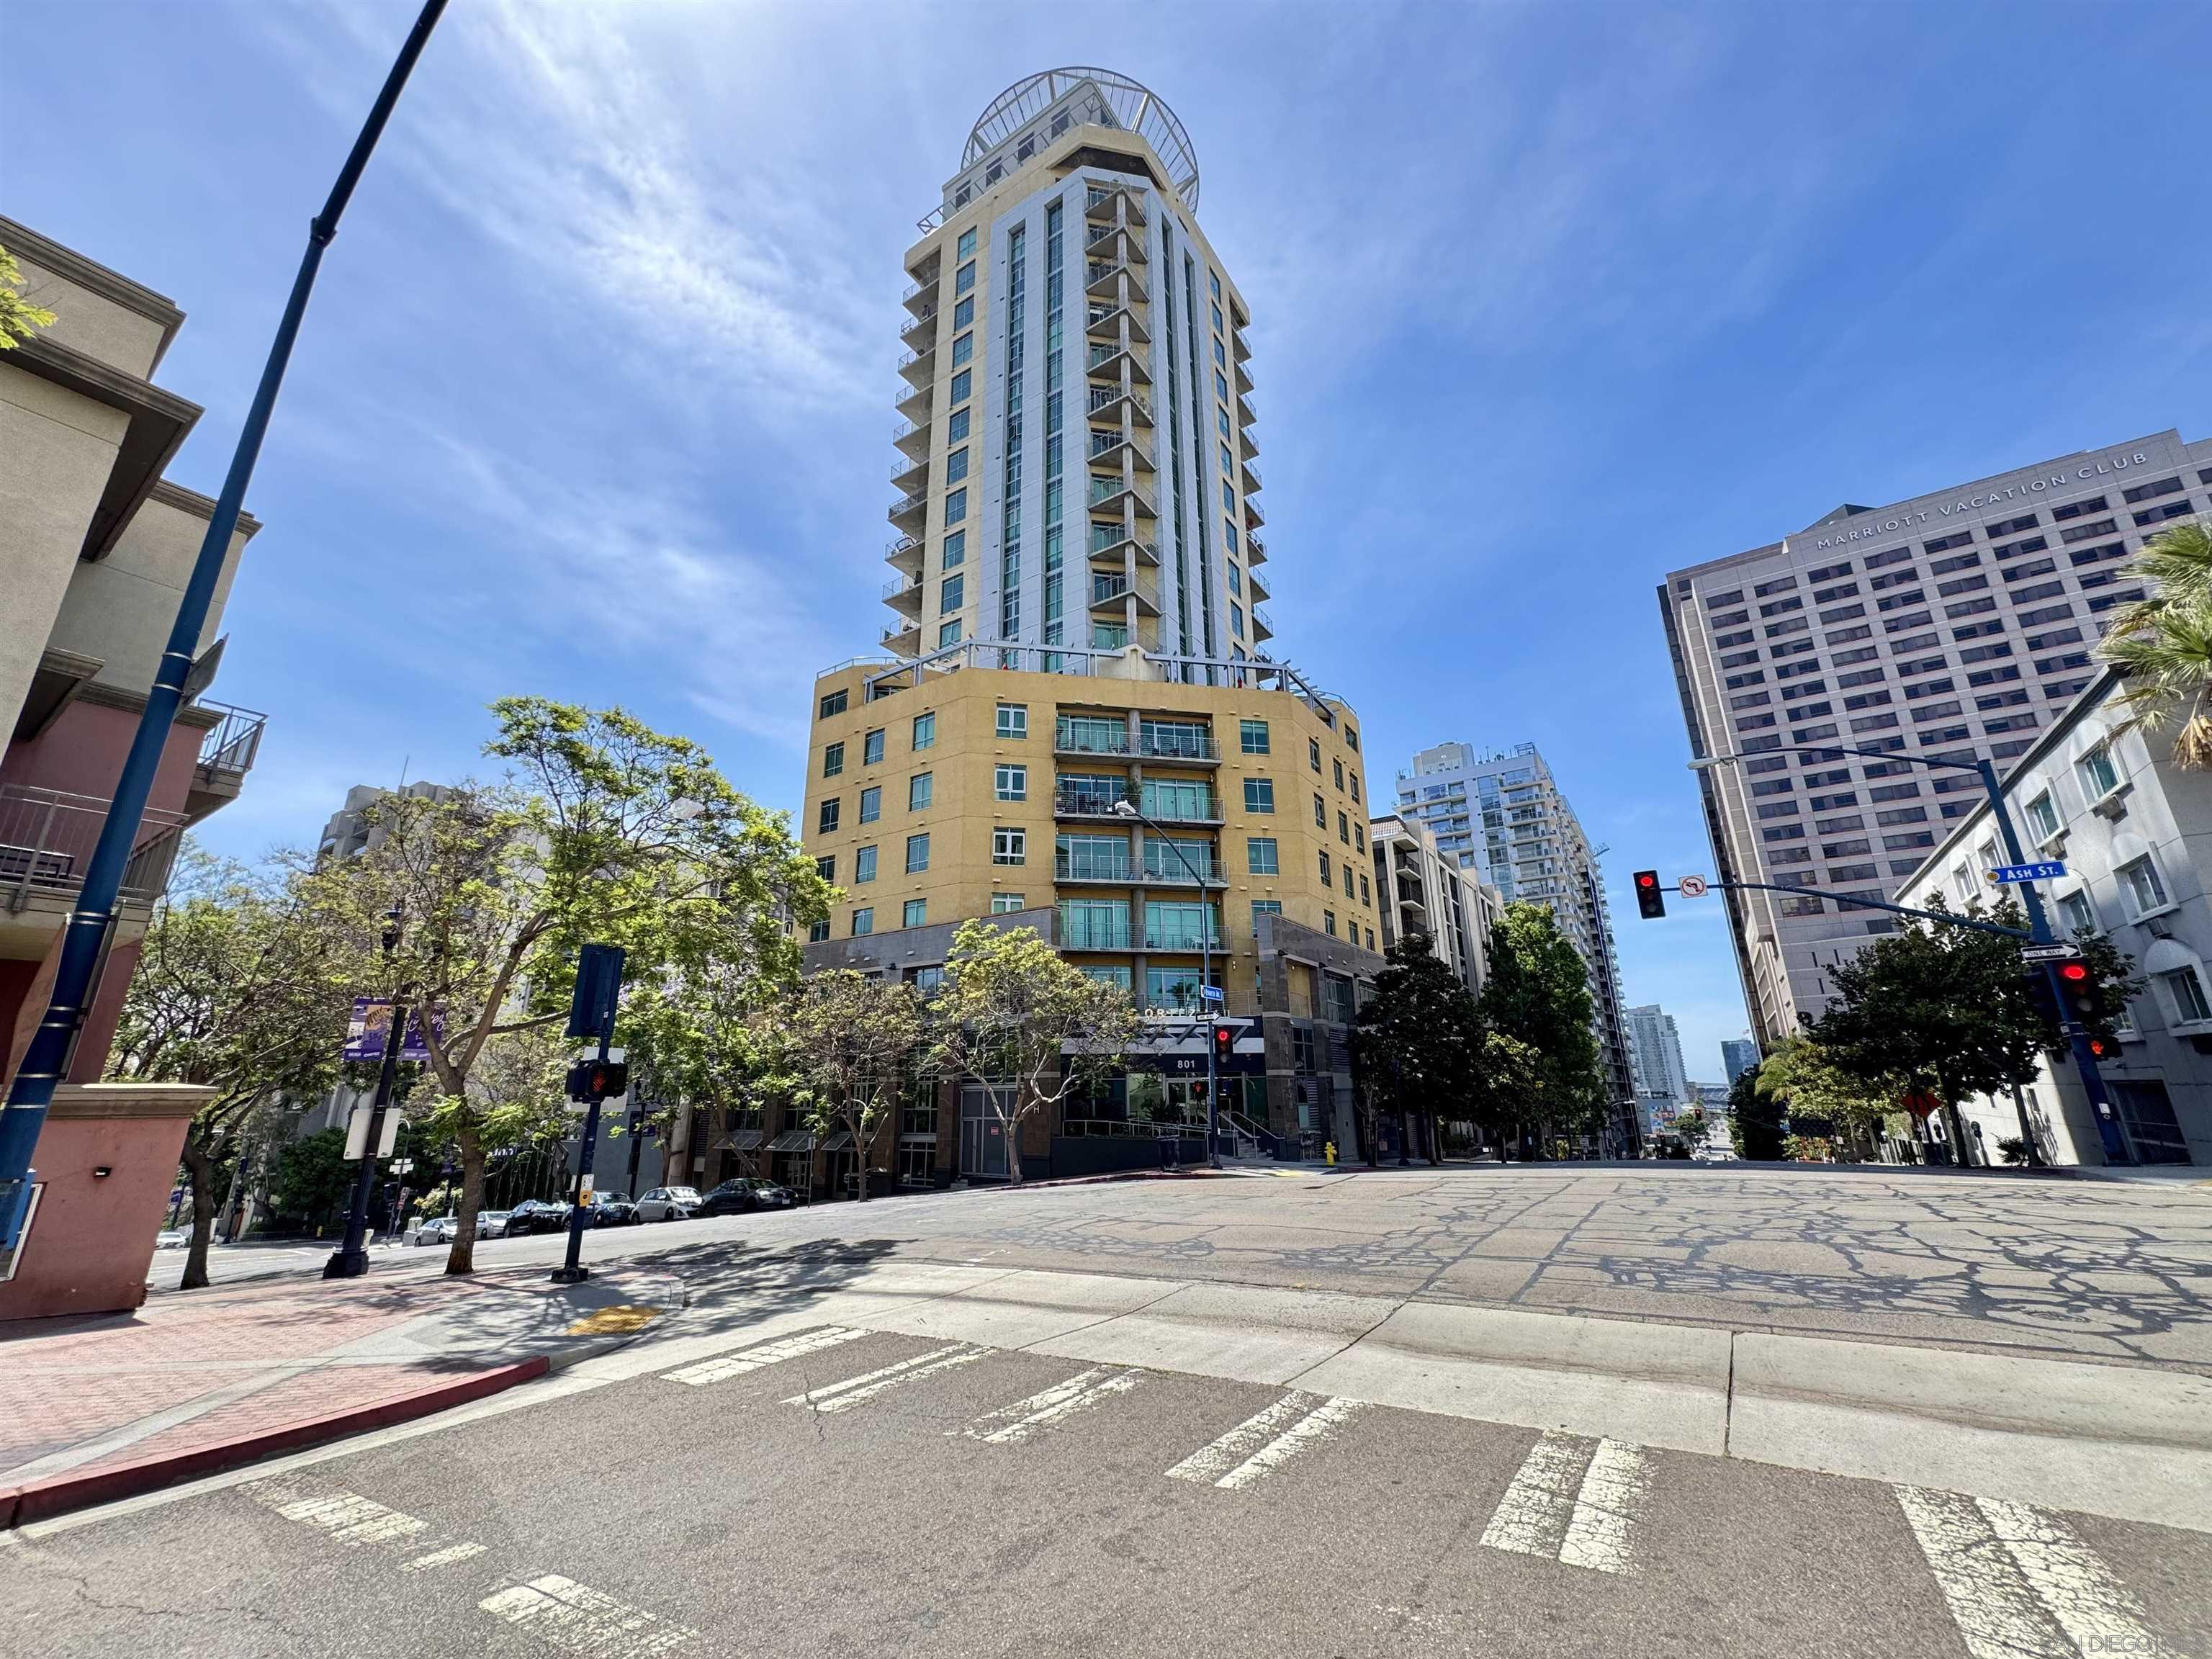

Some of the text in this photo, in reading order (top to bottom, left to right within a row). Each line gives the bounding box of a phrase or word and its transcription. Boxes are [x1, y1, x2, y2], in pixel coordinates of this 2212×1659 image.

[1817, 453, 2146, 549] MARRIOTT VACATION CLUB
[1177, 1060, 1195, 1069] 801
